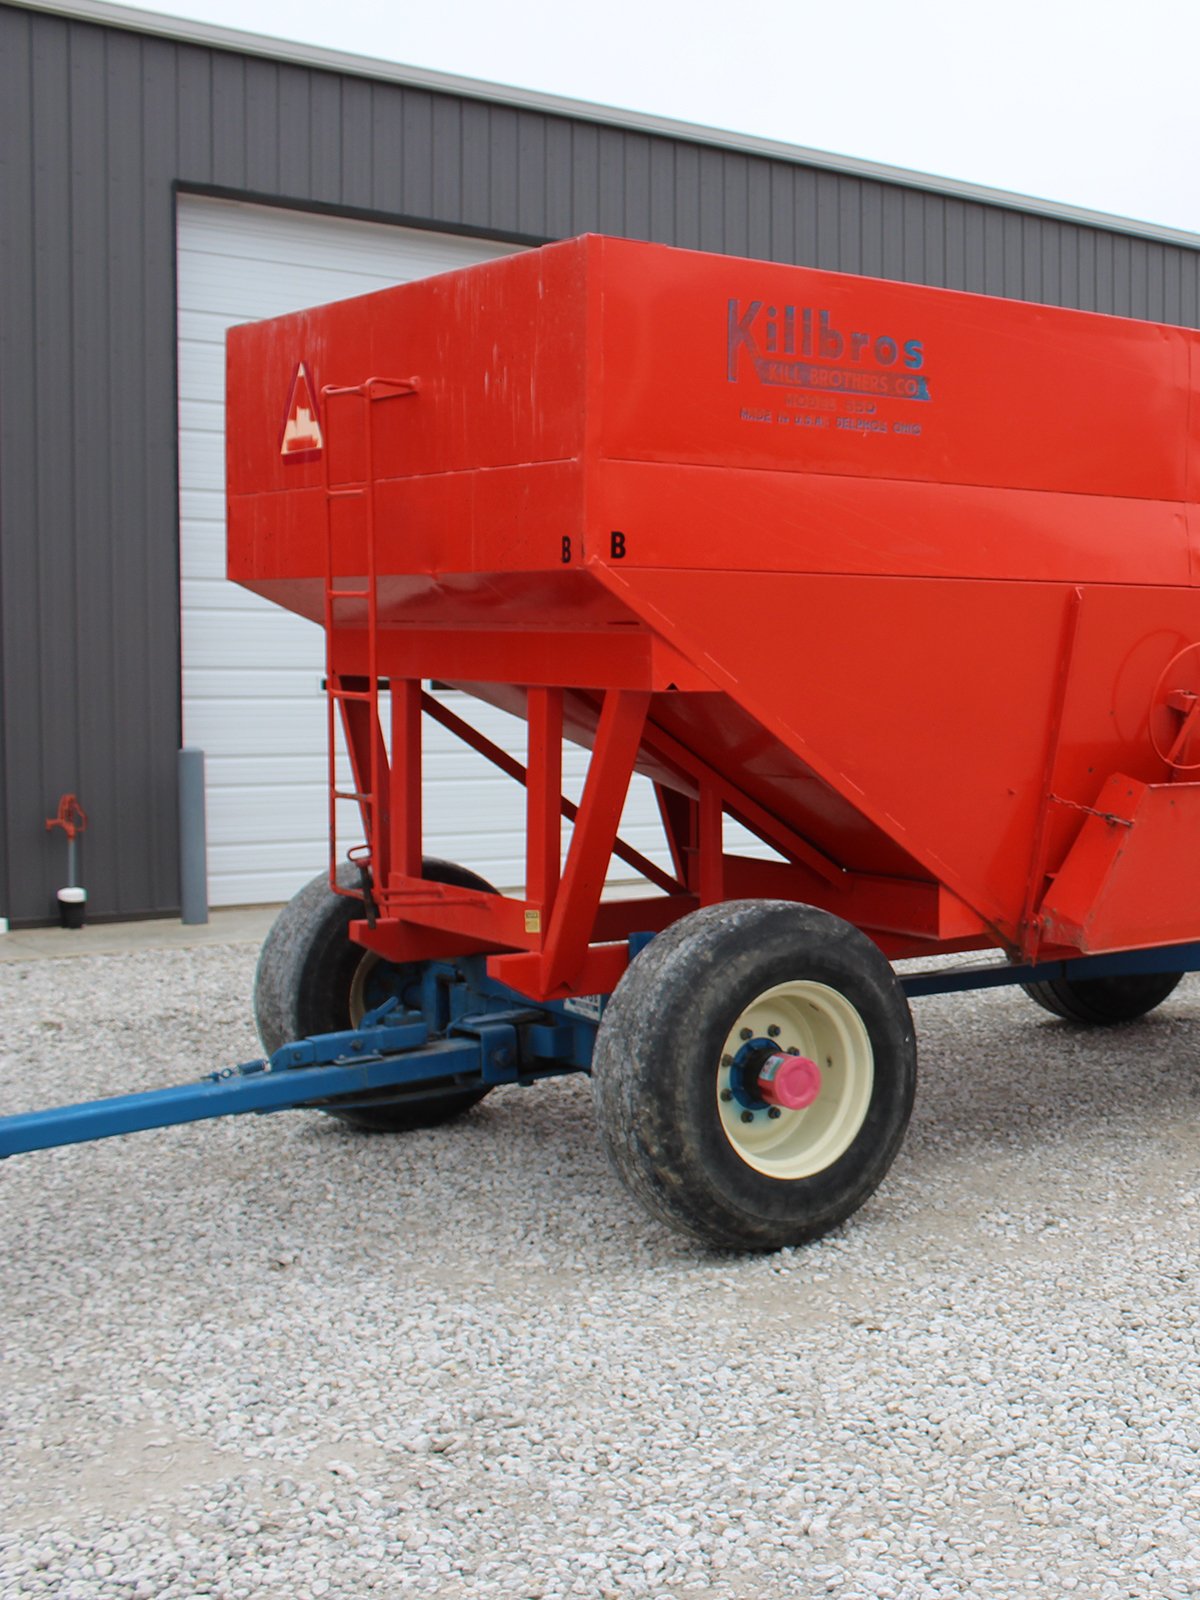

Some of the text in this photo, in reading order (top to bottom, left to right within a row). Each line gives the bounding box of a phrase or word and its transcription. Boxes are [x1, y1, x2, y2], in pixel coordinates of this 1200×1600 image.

[727, 298, 924, 384] Killbros
[809, 368, 888, 394] BROTHERS
[562, 535, 571, 563] B
[611, 531, 626, 559] B
